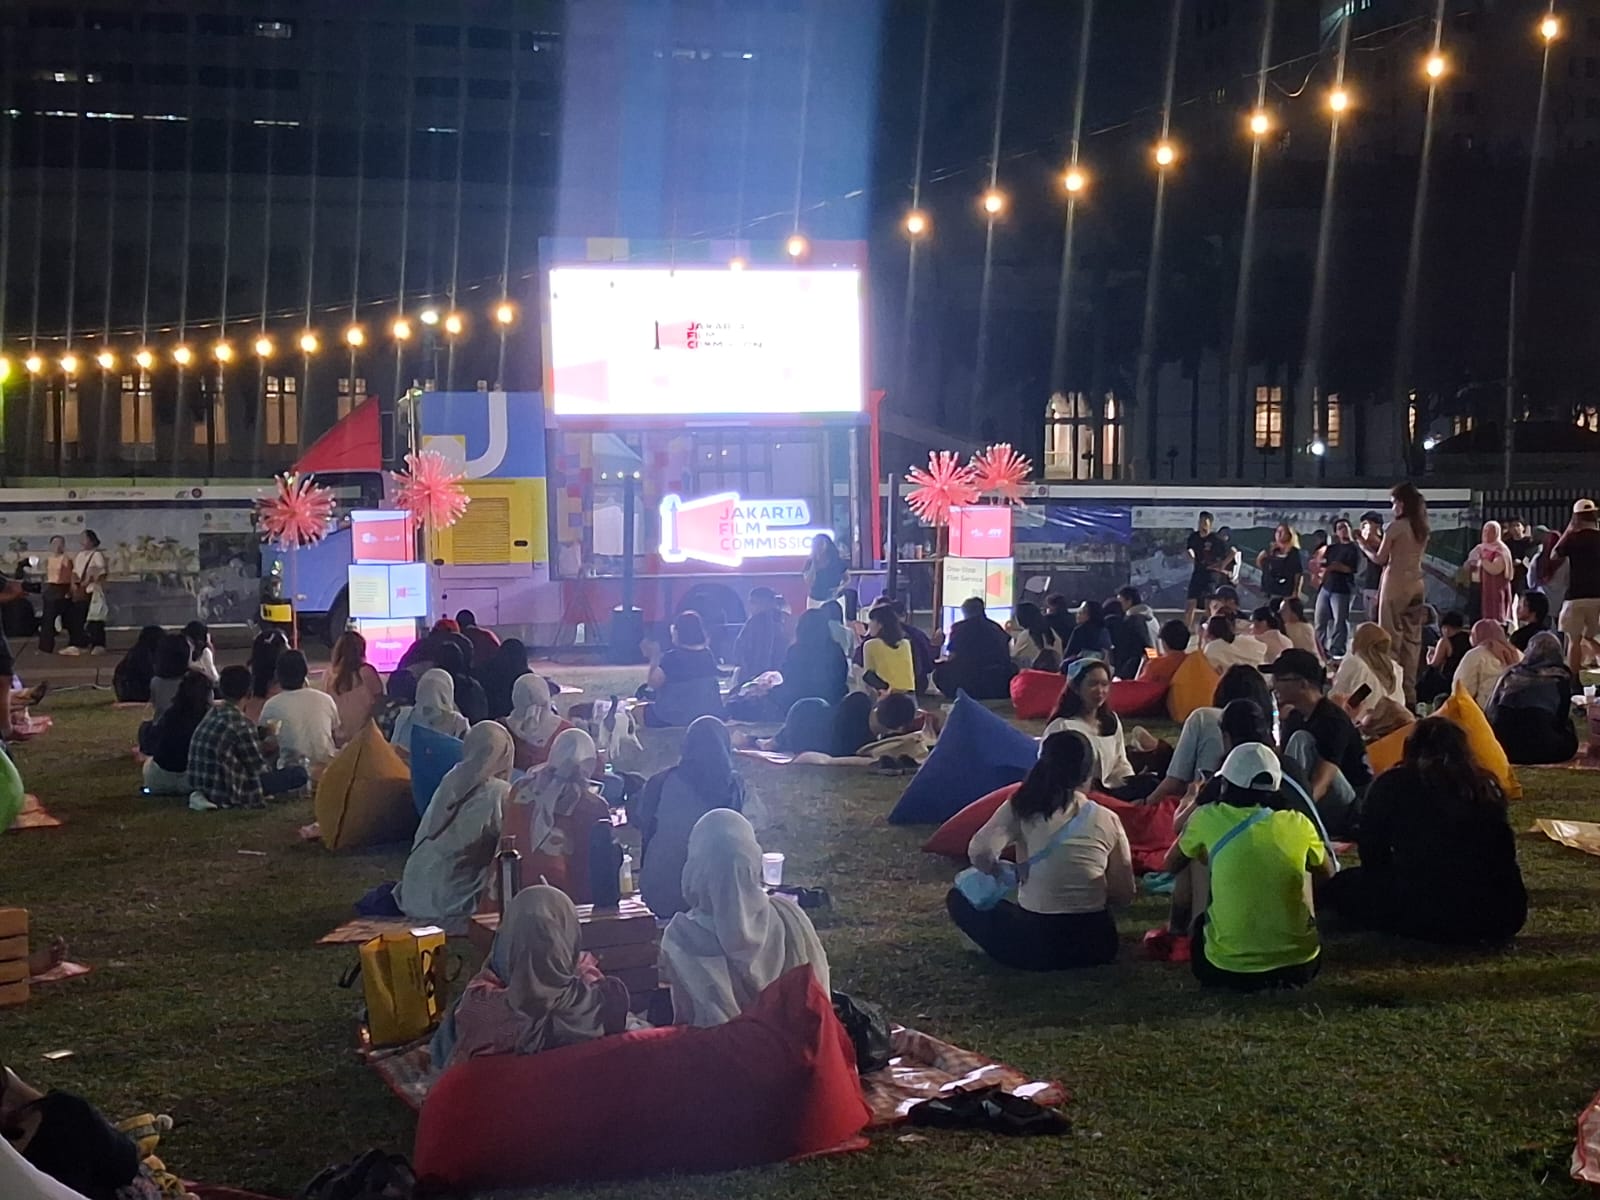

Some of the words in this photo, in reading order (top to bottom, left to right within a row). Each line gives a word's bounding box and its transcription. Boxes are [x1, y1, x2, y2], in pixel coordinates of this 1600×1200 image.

[720, 507, 804, 521] JAKARTA
[720, 522, 761, 535] FILM
[721, 537, 812, 551] COMMISSIO
